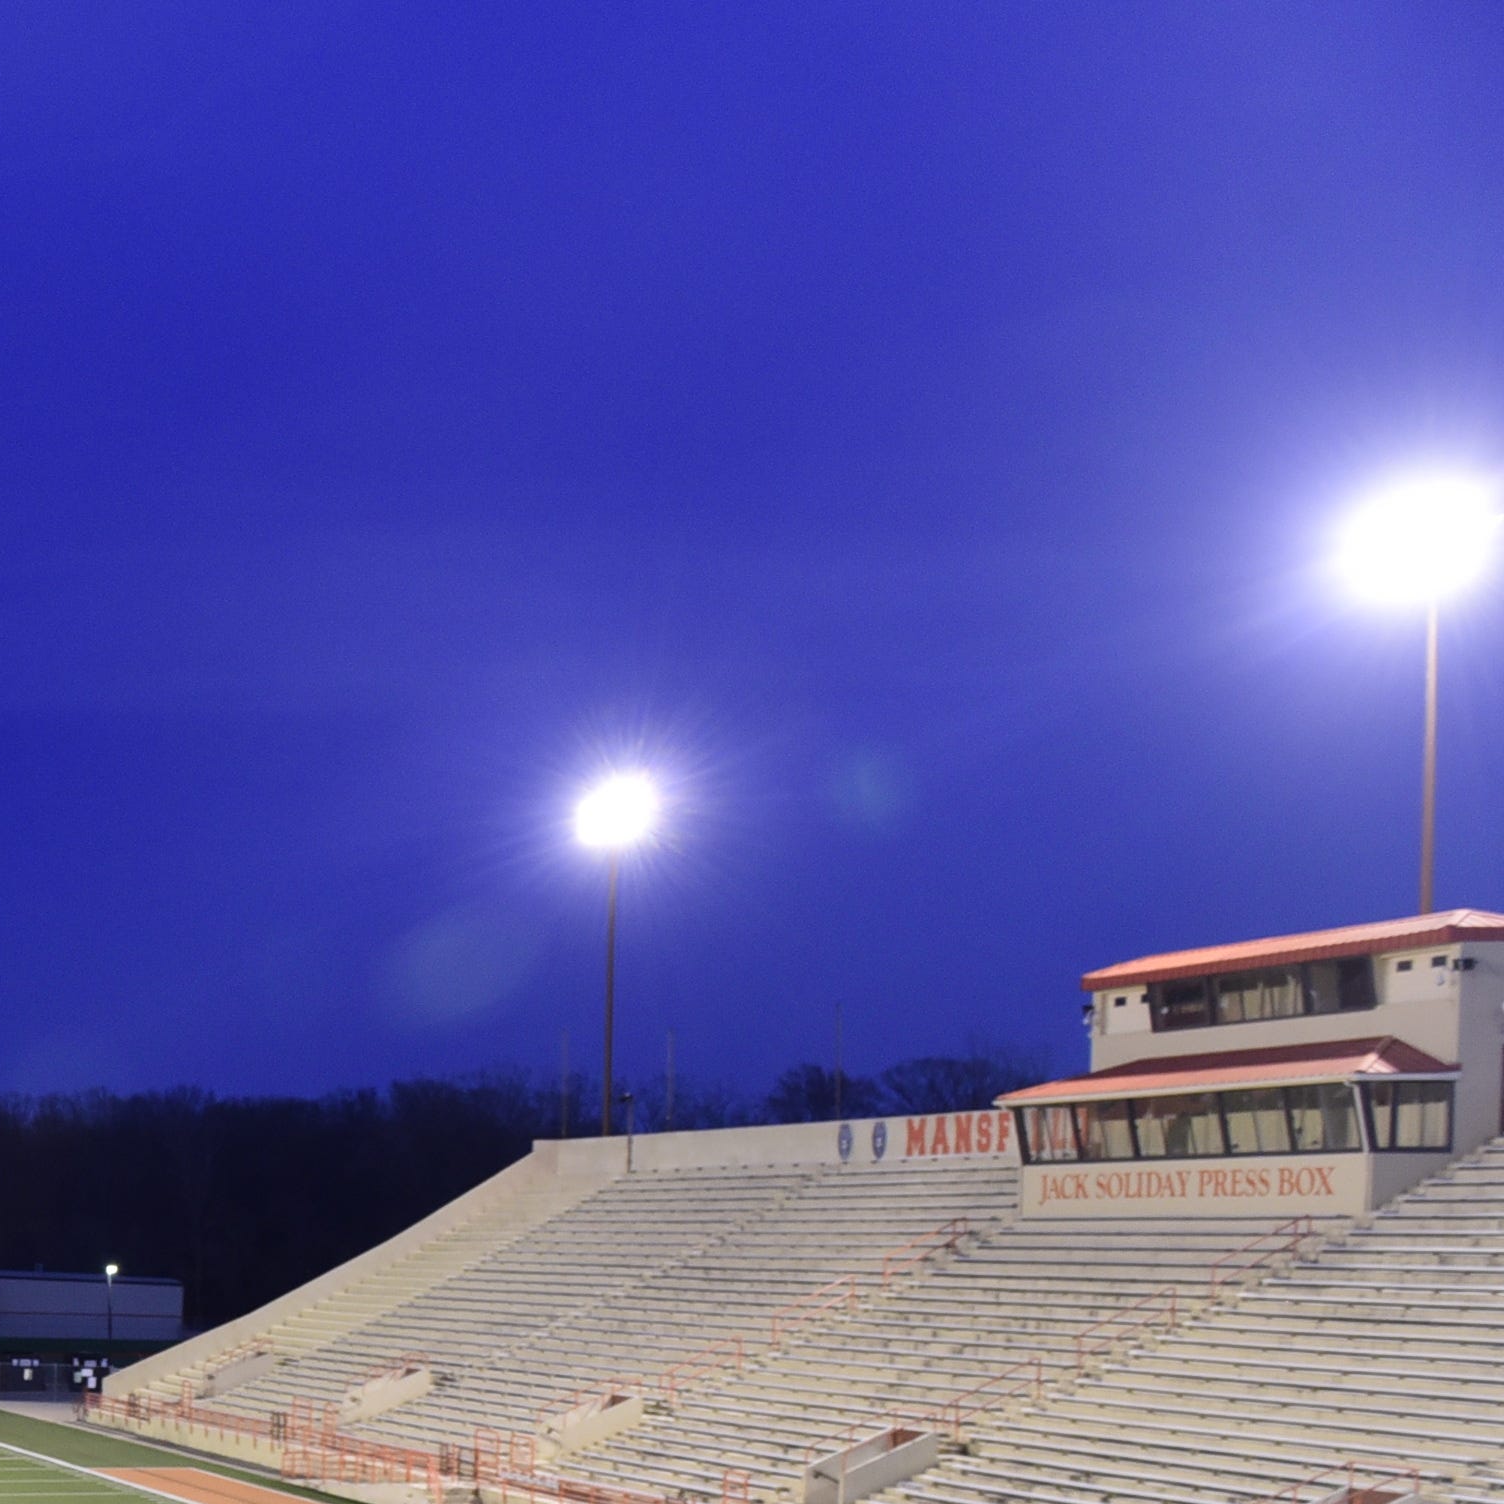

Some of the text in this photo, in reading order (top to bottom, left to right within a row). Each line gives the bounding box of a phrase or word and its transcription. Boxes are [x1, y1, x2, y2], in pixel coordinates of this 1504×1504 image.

[1039, 1167, 1336, 1205] JACK SOLIDAY PRESS BOX
